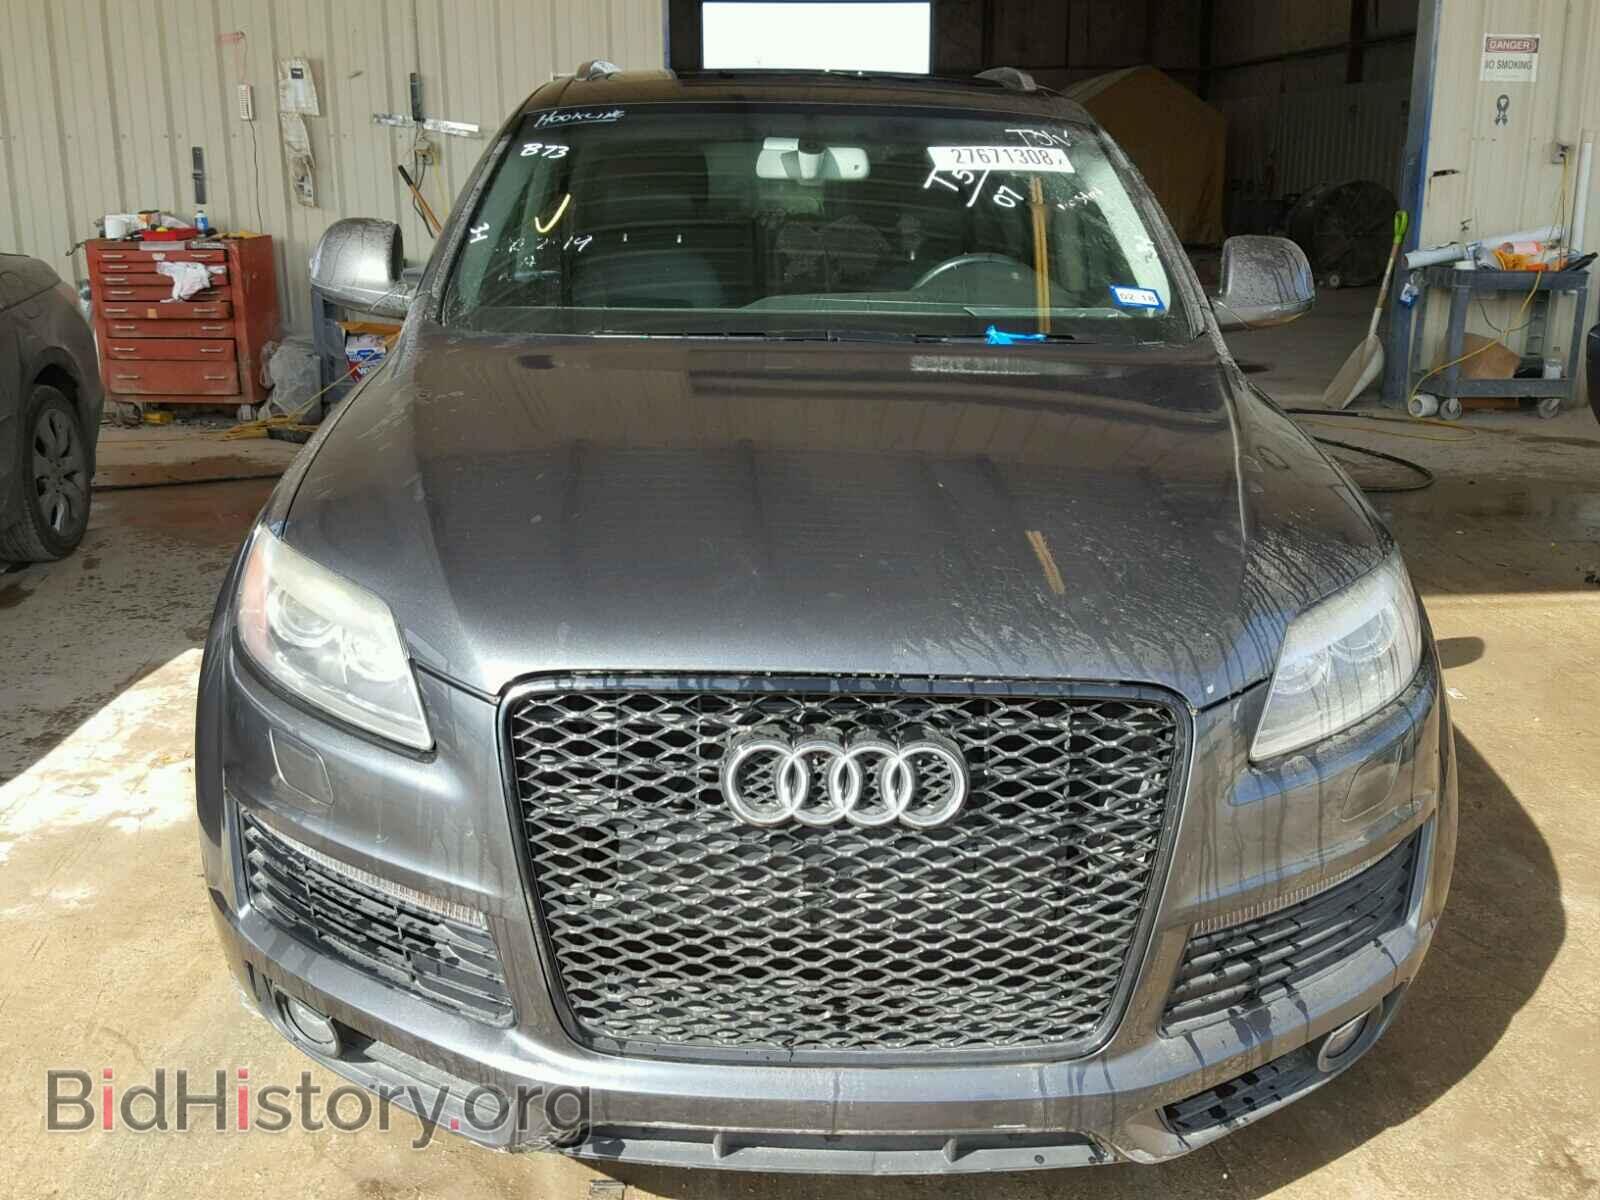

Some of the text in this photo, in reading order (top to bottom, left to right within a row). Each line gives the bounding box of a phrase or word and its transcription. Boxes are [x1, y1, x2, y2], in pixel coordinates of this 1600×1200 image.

[1489, 39, 1531, 50] DANGER
[1496, 60, 1533, 70] SMOKING
[951, 148, 1054, 166] 27671308
